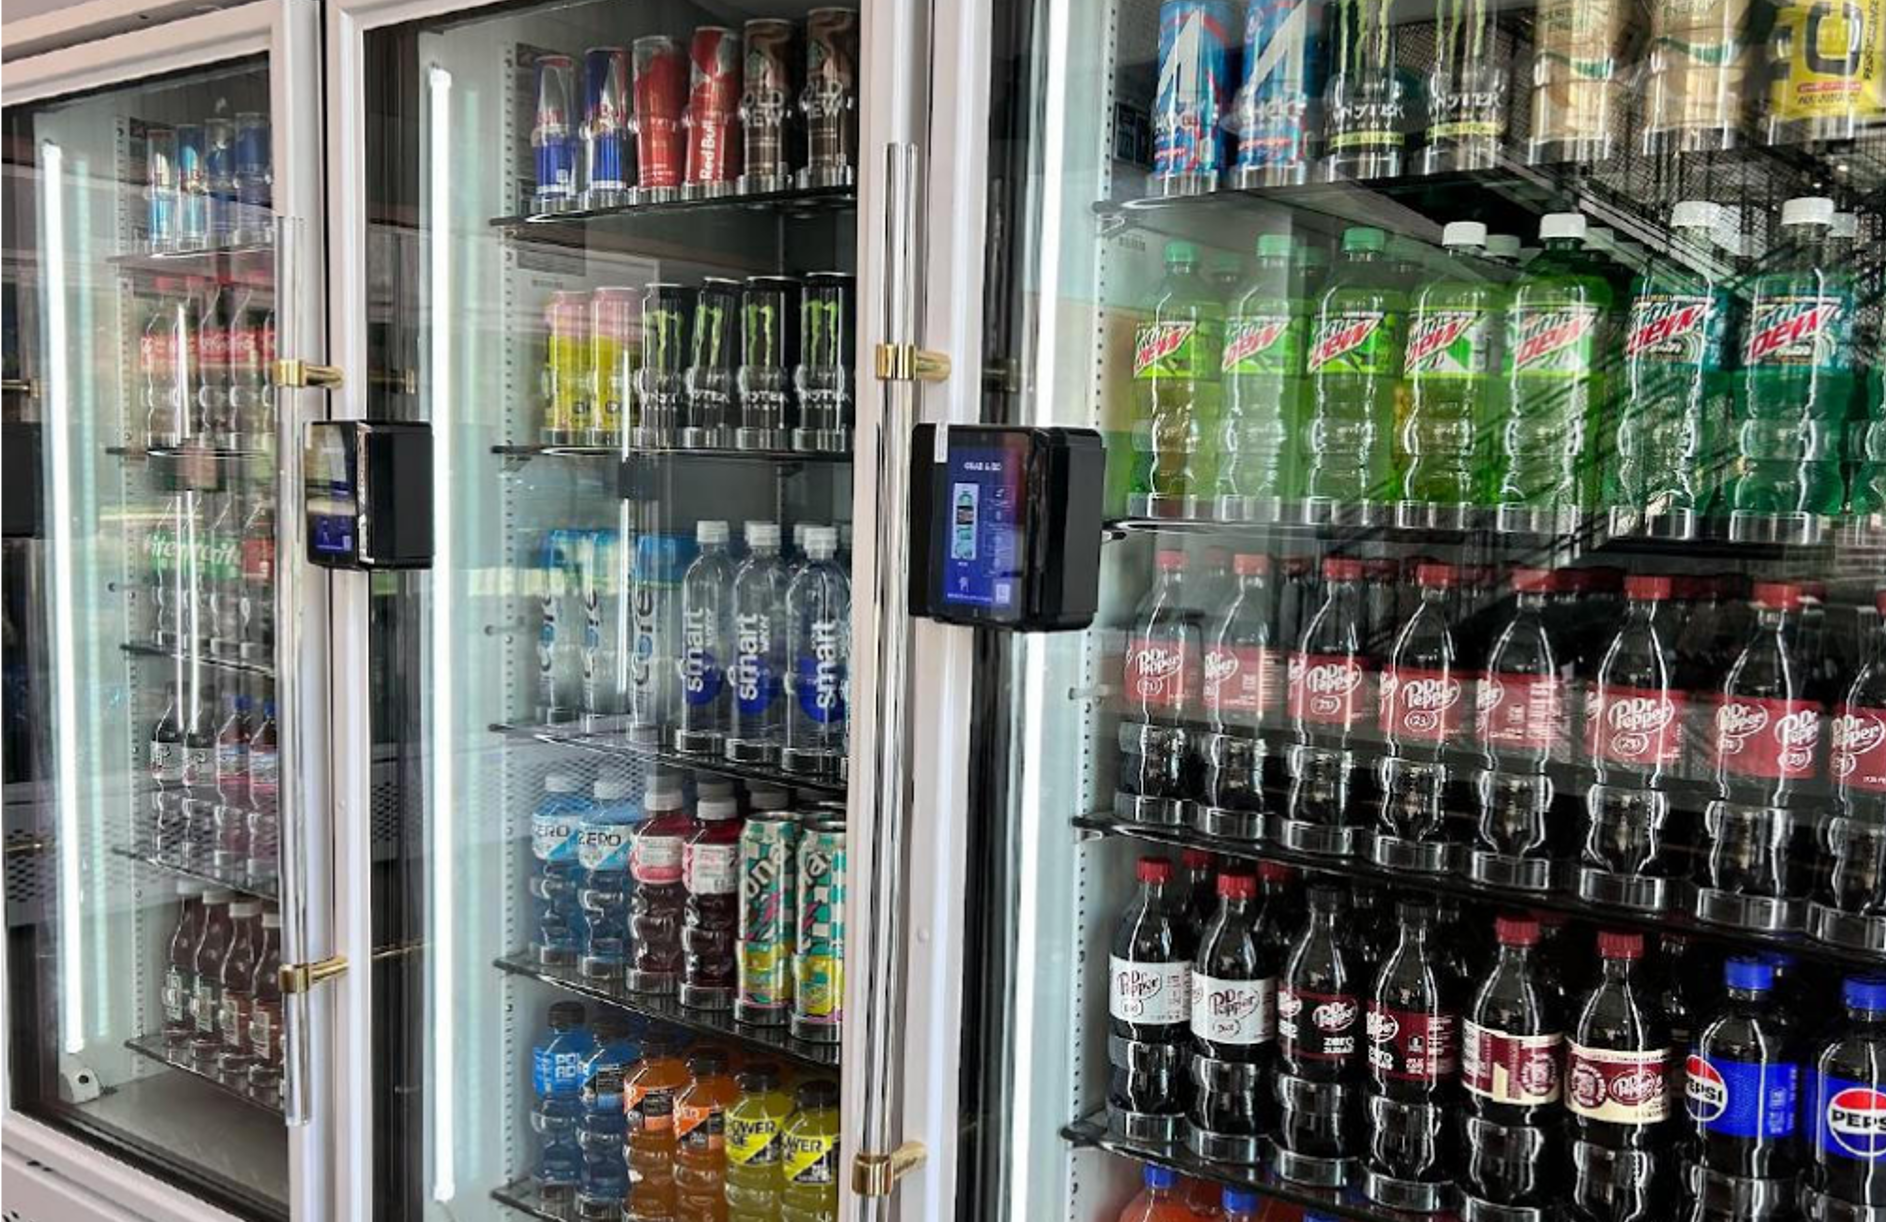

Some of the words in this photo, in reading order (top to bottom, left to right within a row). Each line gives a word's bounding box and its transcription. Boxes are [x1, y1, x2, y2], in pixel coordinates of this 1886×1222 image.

[741, 88, 784, 107] OLD
[801, 79, 843, 101] OLD
[743, 106, 784, 128] REW
[701, 118, 717, 150] Bull
[699, 150, 715, 181] Red
[688, 607, 705, 693] smart
[740, 612, 758, 701] smart
[1151, 648, 1168, 662] Dr
[812, 618, 837, 709] smart
[1136, 651, 1181, 676] Pepper
[1327, 663, 1346, 678] Dr
[1308, 666, 1359, 693] Pepper
[1424, 678, 1442, 693] Dr
[1404, 681, 1457, 709] Pepper
[1633, 696, 1656, 716] Dr
[1610, 700, 1669, 730] Pepper
[1717, 706, 1764, 734] Pepper
[1731, 704, 1750, 720] Dr
[1801, 710, 1817, 726] Dr
[1845, 714, 1865, 733] Dr
[1777, 714, 1819, 746] Pepp
[1832, 718, 1881, 749] Pepper
[534, 824, 570, 838] ERO
[578, 830, 621, 847] ZERO
[1117, 971, 1158, 998] Pepper
[1131, 969, 1148, 984] Dr
[1210, 991, 1256, 1018] Pepper
[1226, 988, 1244, 1001] Dr
[1688, 1078, 1724, 1104] EPSI
[1831, 1109, 1886, 1137] PEPS
[787, 1137, 823, 1153] WER
